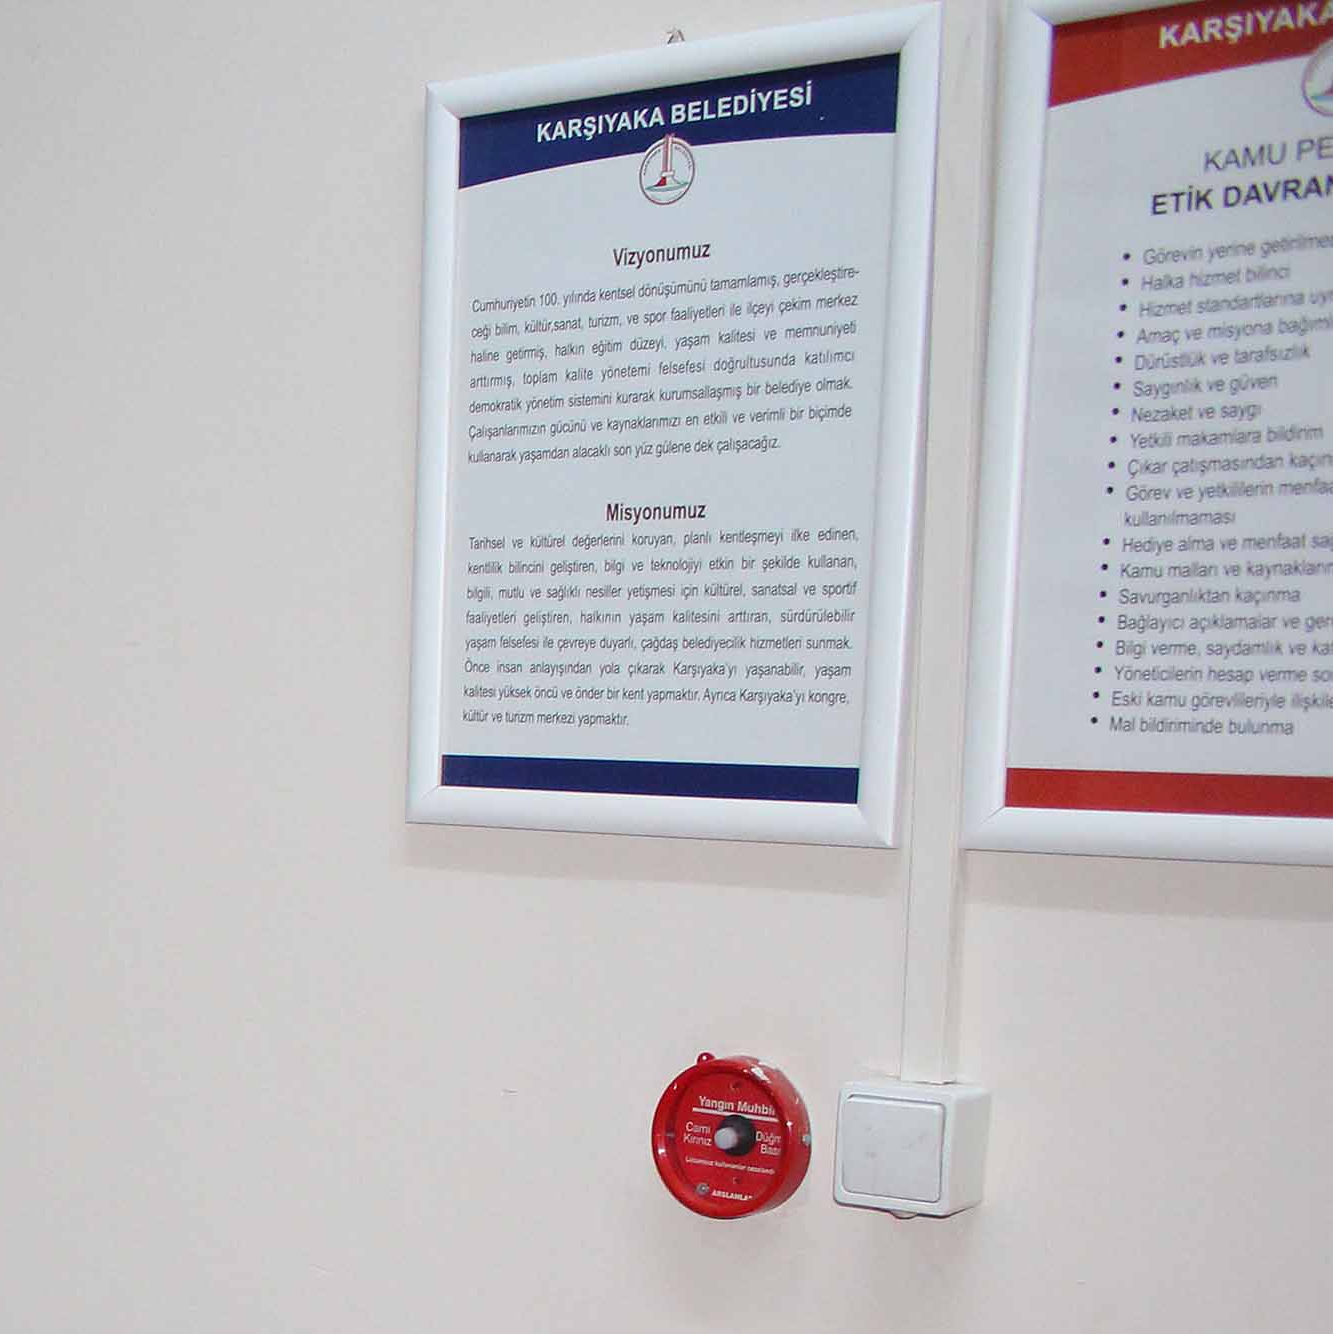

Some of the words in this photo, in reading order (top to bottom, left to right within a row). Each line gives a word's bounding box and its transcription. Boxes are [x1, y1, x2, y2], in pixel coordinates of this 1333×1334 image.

[537, 107, 665, 143] KARŞIYAKA
[671, 80, 813, 126] BELEDİYESİ
[1203, 142, 1287, 173] KAMU
[1151, 185, 1214, 215] ETİK
[613, 241, 711, 269] Vizyonumuz
[605, 501, 707, 525] Misyonumuz
